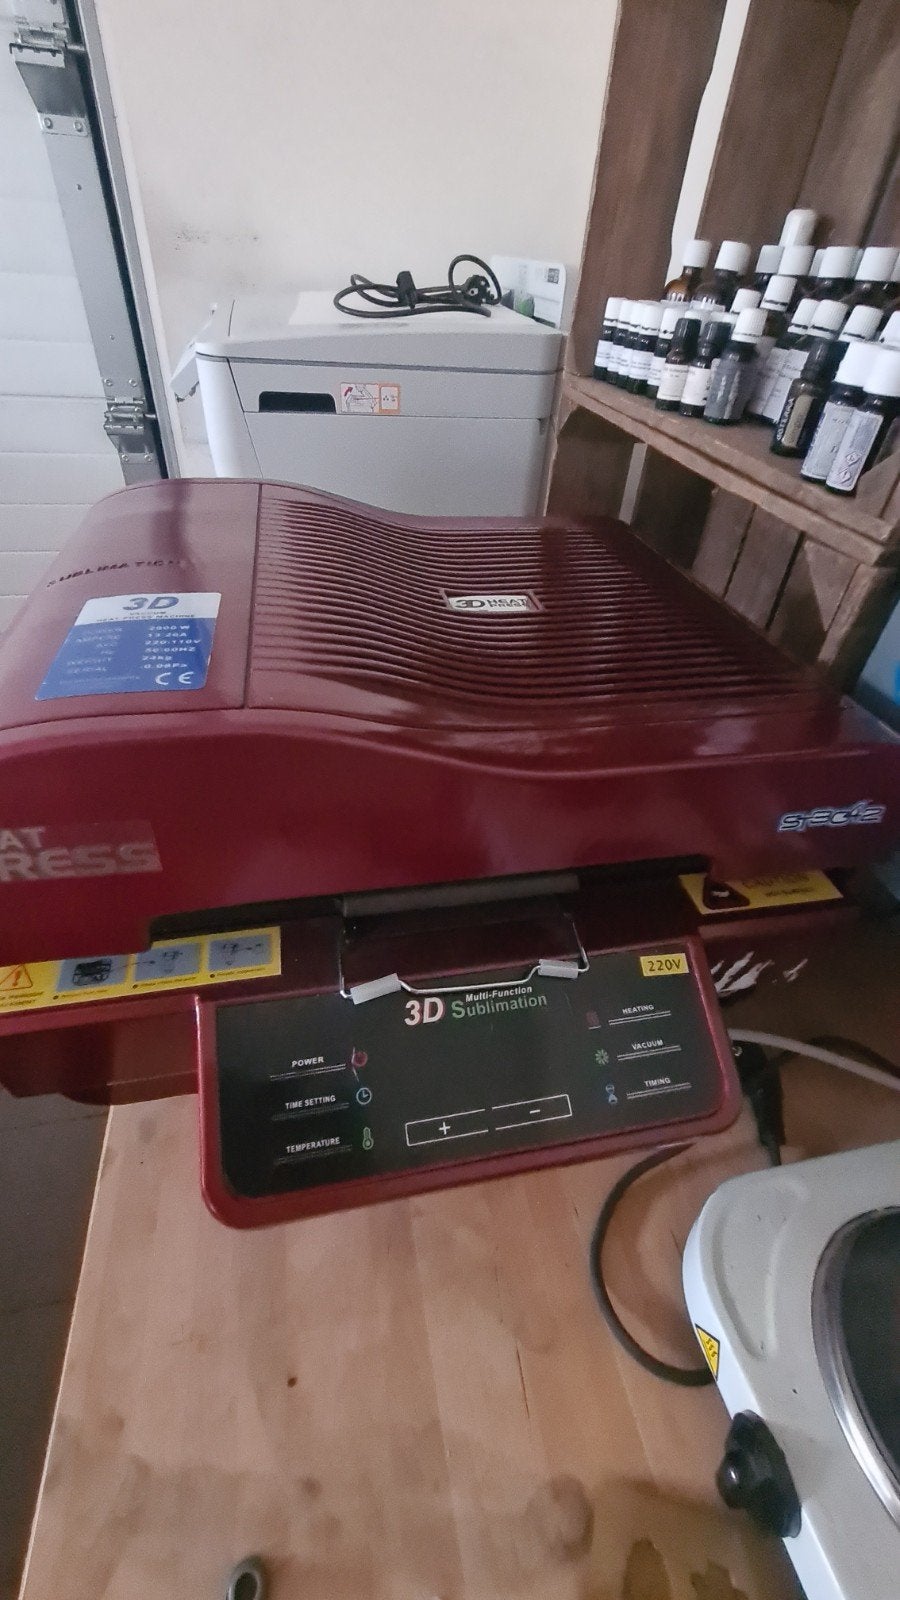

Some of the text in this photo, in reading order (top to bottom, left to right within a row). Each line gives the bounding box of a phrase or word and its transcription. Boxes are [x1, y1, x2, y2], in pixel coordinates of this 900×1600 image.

[123, 596, 180, 611] 3D
[454, 599, 486, 608] 3D
[648, 958, 681, 972] 220V
[465, 985, 533, 1002] Multi-Function
[404, 994, 547, 1026] 3D Sublimation
[622, 1004, 655, 1015] HEATING
[631, 1039, 664, 1050] VACUUM
[291, 1056, 325, 1068] POWER
[643, 1077, 671, 1088] TIMING
[285, 1095, 336, 1110] TIME SETTING
[286, 1137, 341, 1154] TEMPERATURE
